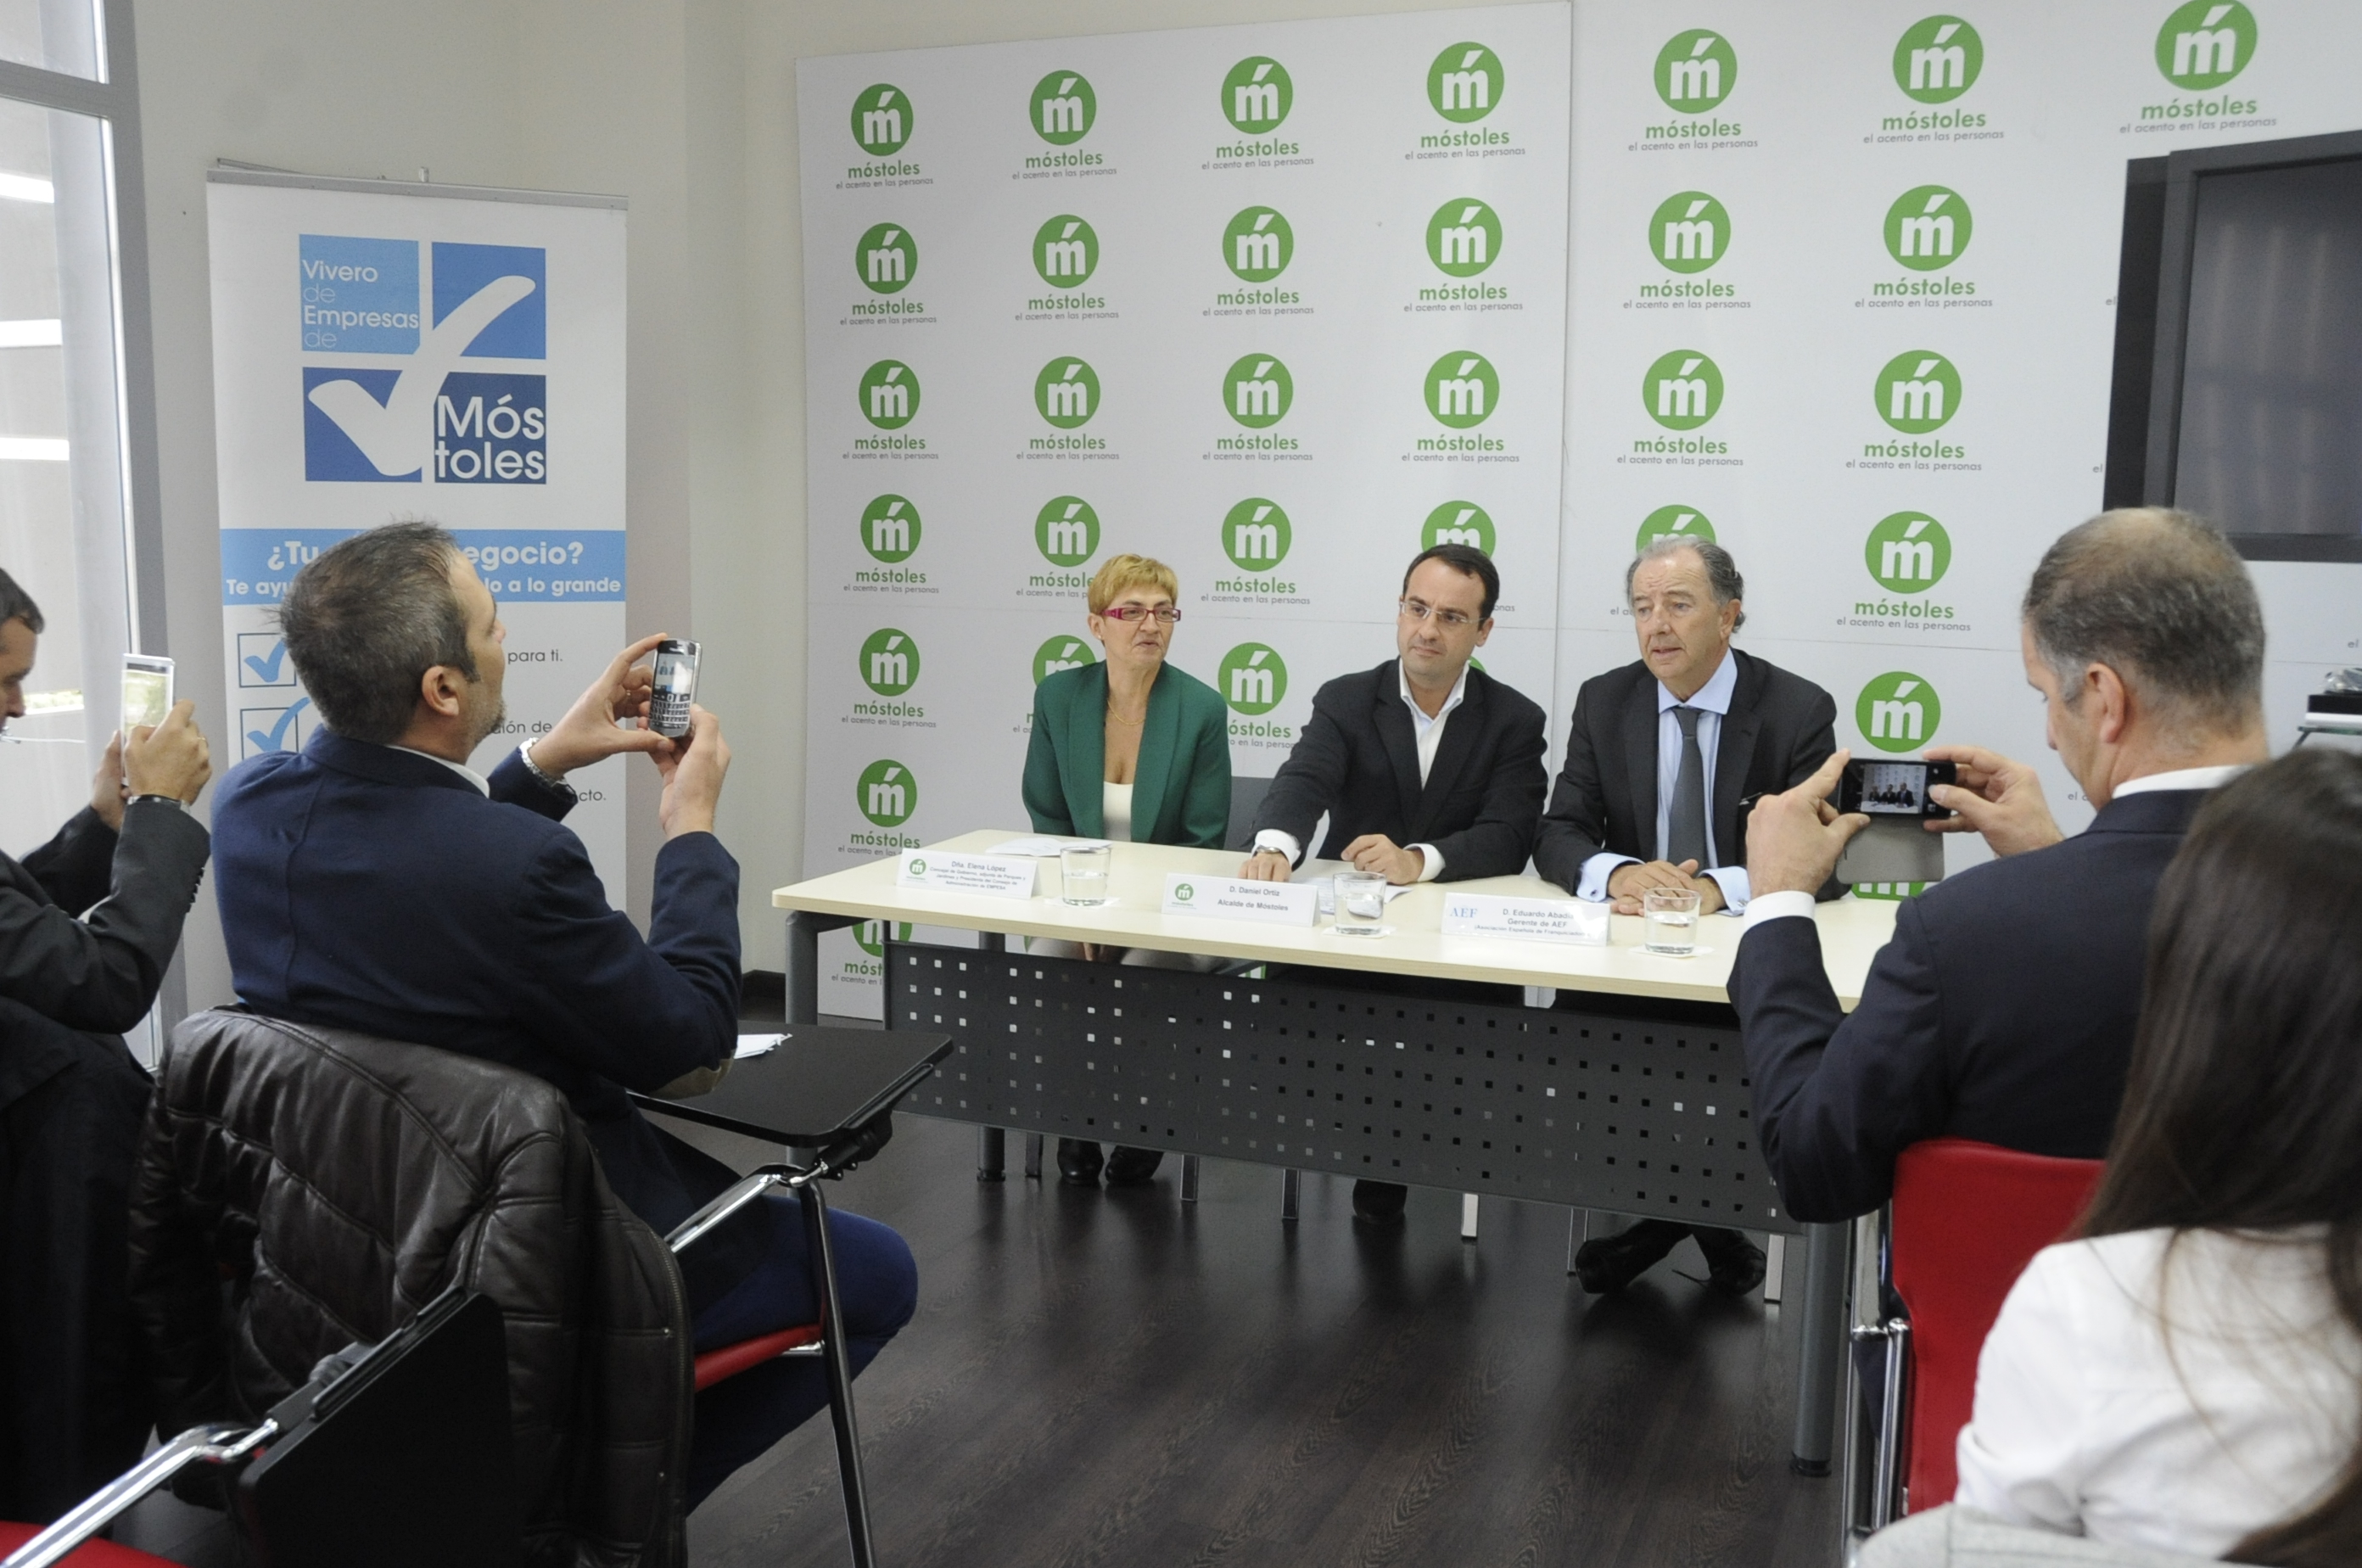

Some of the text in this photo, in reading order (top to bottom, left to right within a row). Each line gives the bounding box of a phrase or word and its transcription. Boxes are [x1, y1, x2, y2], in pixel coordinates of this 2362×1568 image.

[2141, 94, 2258, 120] móstoles
[1645, 117, 1742, 139] móstoles
[1882, 108, 1987, 131] móstoles
[2119, 118, 2277, 134] el acento en las personas
[1420, 126, 1510, 148] móstoles
[1627, 139, 1759, 152] el acento en las personas
[1862, 131, 2005, 144] el acento en las personas
[1216, 137, 1300, 159] móstoles
[1025, 148, 1104, 169] móstoles
[848, 159, 921, 179] móstoles
[1011, 171, 1021, 180] el
[1021, 171, 1050, 180] acento
[1064, 168, 1077, 177] las
[1079, 167, 1118, 178] personas
[302, 259, 378, 283] Vivero
[303, 283, 336, 303] de
[1419, 281, 1508, 301] móstoles
[1639, 278, 1735, 298] móstoles
[1872, 276, 1976, 296] móstoles
[1028, 292, 1105, 311] móstoles
[1217, 286, 1300, 305] móstoles
[1854, 297, 1994, 310] el acento en las personas
[852, 297, 925, 316] móstoles
[1201, 307, 1212, 316] el
[1212, 308, 1244, 316] acento
[1258, 305, 1273, 316] las
[1273, 307, 1315, 316] personas
[1403, 302, 1413, 312] el
[1414, 303, 1447, 312] acento
[1464, 301, 1478, 311] las
[1480, 303, 1524, 313] personas
[304, 305, 420, 330] Empresas
[304, 329, 337, 349] de
[437, 393, 545, 440] Mós
[854, 434, 926, 450] móstoles
[1029, 433, 1106, 450] móstoles
[1217, 433, 1299, 451] móstoles
[1417, 433, 1505, 451] móstoles
[1633, 435, 1728, 455] móstoles
[1863, 439, 1965, 459] móstoles
[434, 440, 546, 480] toles
[1616, 454, 1626, 464] el
[1629, 456, 1663, 465] acento
[1680, 455, 1695, 465] las
[1698, 458, 1744, 468] personas
[1844, 458, 1856, 468] el
[1858, 461, 1895, 469] acento
[1914, 460, 1930, 470] las
[1933, 462, 1982, 473] personas
[462, 541, 585, 572] egocio?
[855, 567, 926, 584] móstoles
[1029, 571, 1094, 588] móstole
[1215, 575, 1296, 594] móstoles
[226, 579, 249, 595] Te
[507, 580, 522, 593] a
[527, 577, 546, 593] lo
[551, 577, 621, 597] grande
[1200, 593, 1210, 602] el
[1211, 595, 1240, 603] acento
[1256, 594, 1269, 604] las
[1270, 596, 1311, 605] personas
[1855, 597, 1955, 619] móstoles
[1836, 616, 1847, 626] el
[1849, 619, 1885, 628] acento
[1904, 619, 1920, 630] las
[1923, 622, 1972, 632] personas
[507, 648, 563, 664] para ti.
[854, 699, 925, 718] móstoles
[531, 720, 552, 733] de
[841, 714, 849, 723] el
[888, 717, 901, 726] las
[901, 720, 937, 728] personas
[1229, 720, 1291, 738] óstoles
[850, 831, 921, 849] móstoles
[967, 862, 985, 871] Elena
[987, 864, 1006, 872] López
[1239, 887, 1262, 895] Daniel
[1262, 888, 1280, 897] Ortiz
[1217, 899, 1244, 907] Alcalde
[1257, 902, 1289, 911] Móstoles
[1450, 906, 1478, 919] AEF
[1513, 909, 1545, 918] Eduardo
[1508, 917, 1537, 927] Gerente
